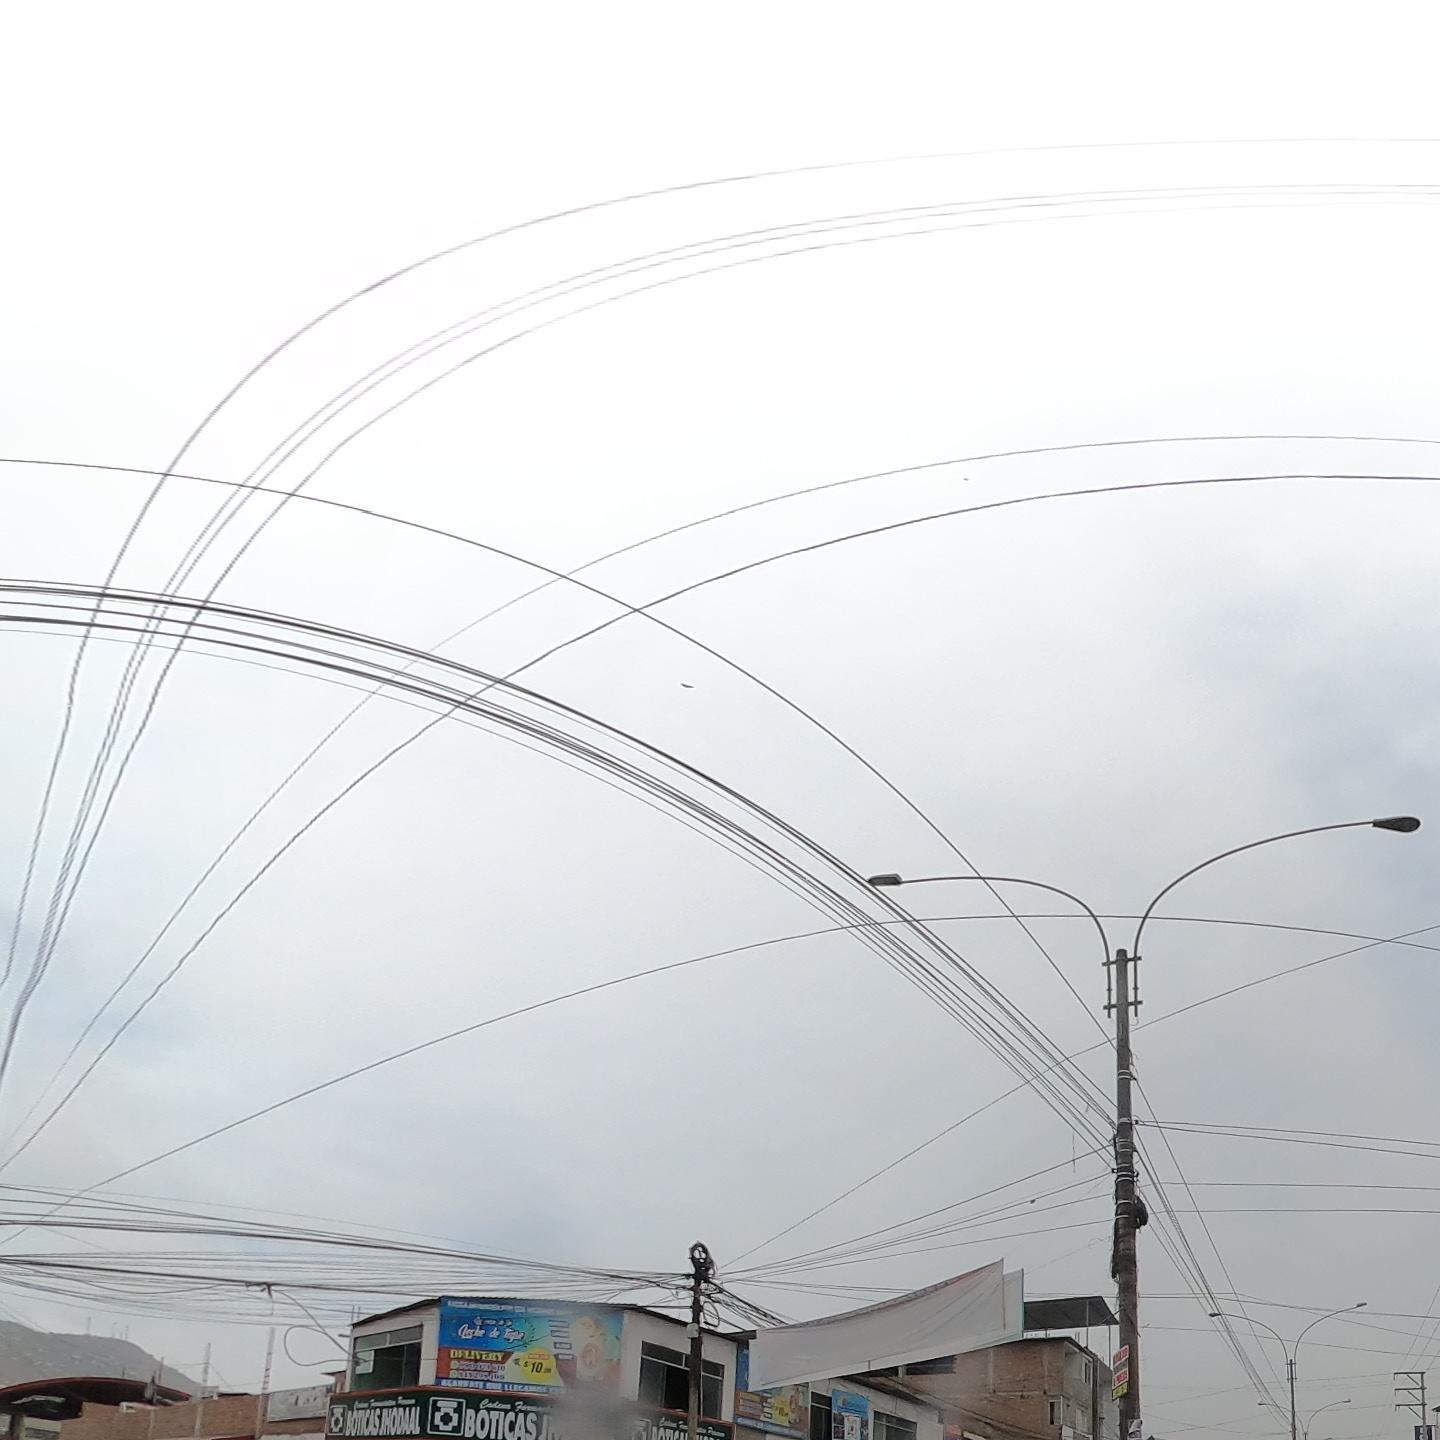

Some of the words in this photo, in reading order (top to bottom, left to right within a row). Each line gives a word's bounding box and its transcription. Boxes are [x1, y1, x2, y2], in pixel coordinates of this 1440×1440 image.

[489, 1327, 501, 1339] de
[450, 1349, 505, 1362] DELIVERY
[346, 1408, 380, 1437] BOTICAS
